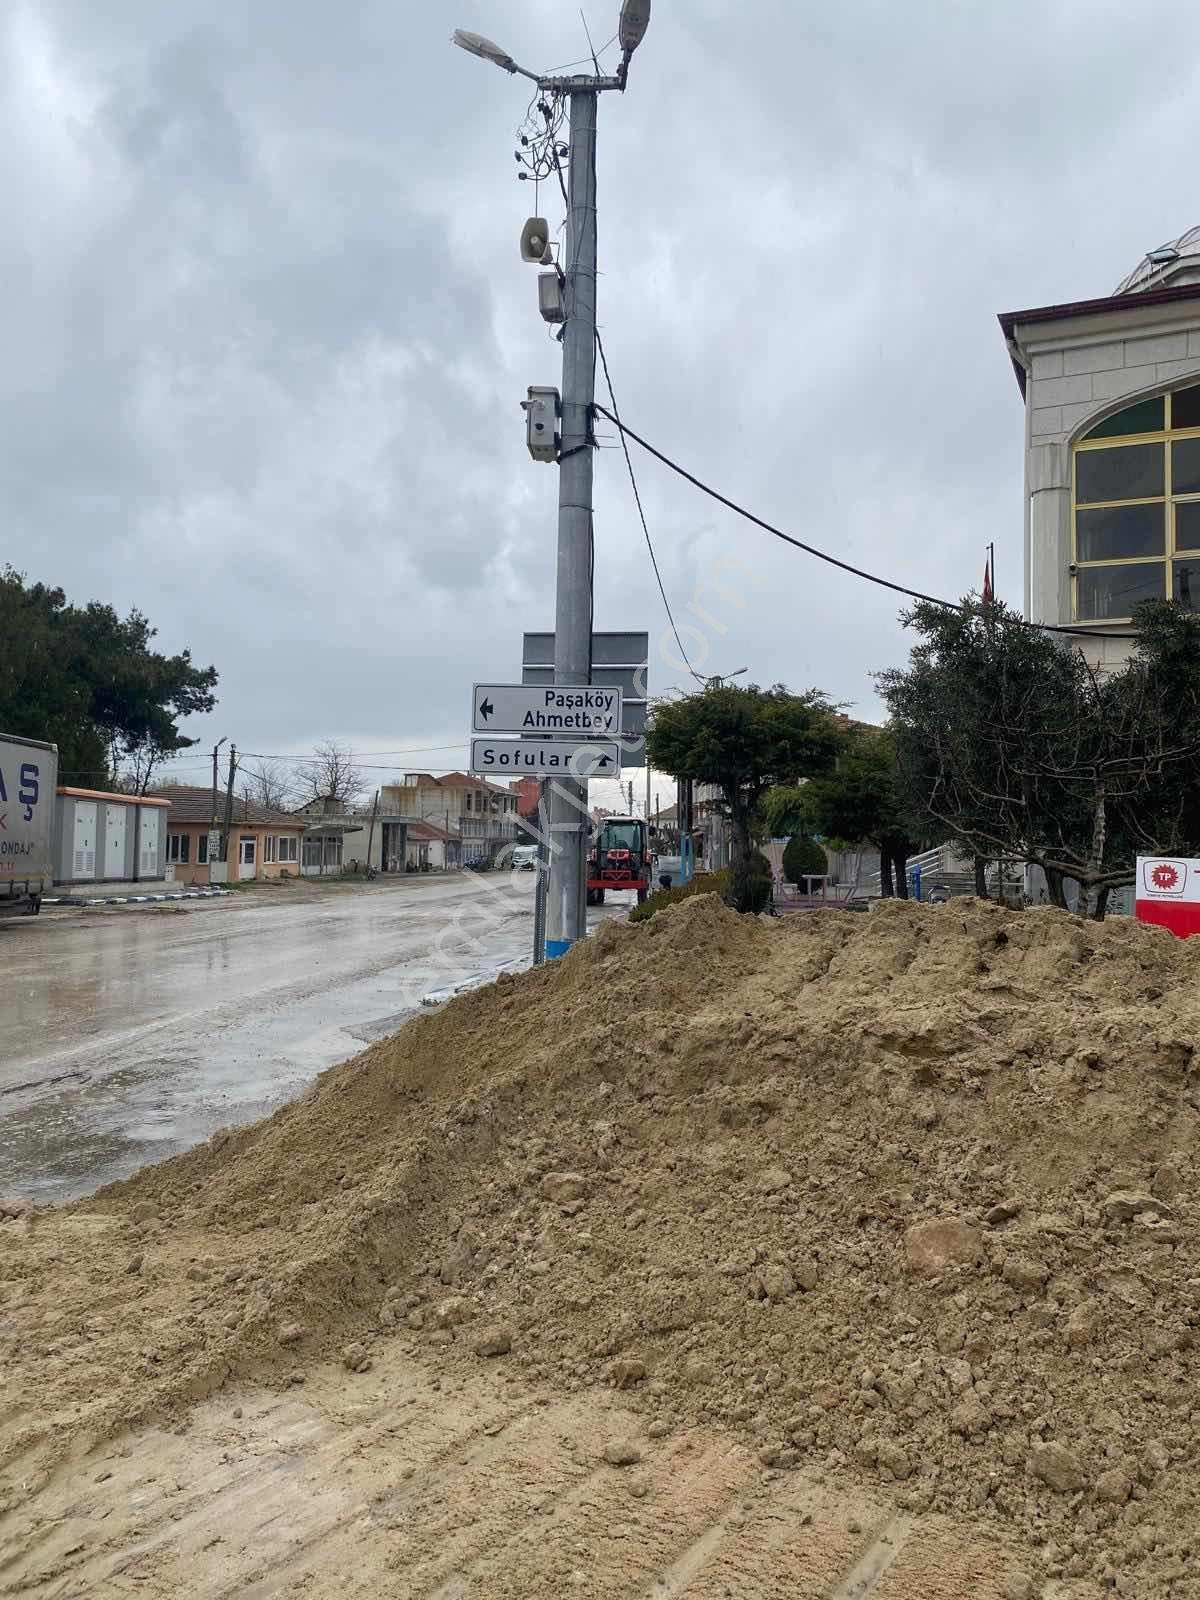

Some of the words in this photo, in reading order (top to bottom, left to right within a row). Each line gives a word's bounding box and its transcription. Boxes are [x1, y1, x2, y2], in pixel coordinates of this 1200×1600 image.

[545, 690, 613, 711] Paşaköy
[523, 710, 612, 731] Ahmetbey
[483, 749, 572, 767] Sofular
[1158, 872, 1171, 881] TP
